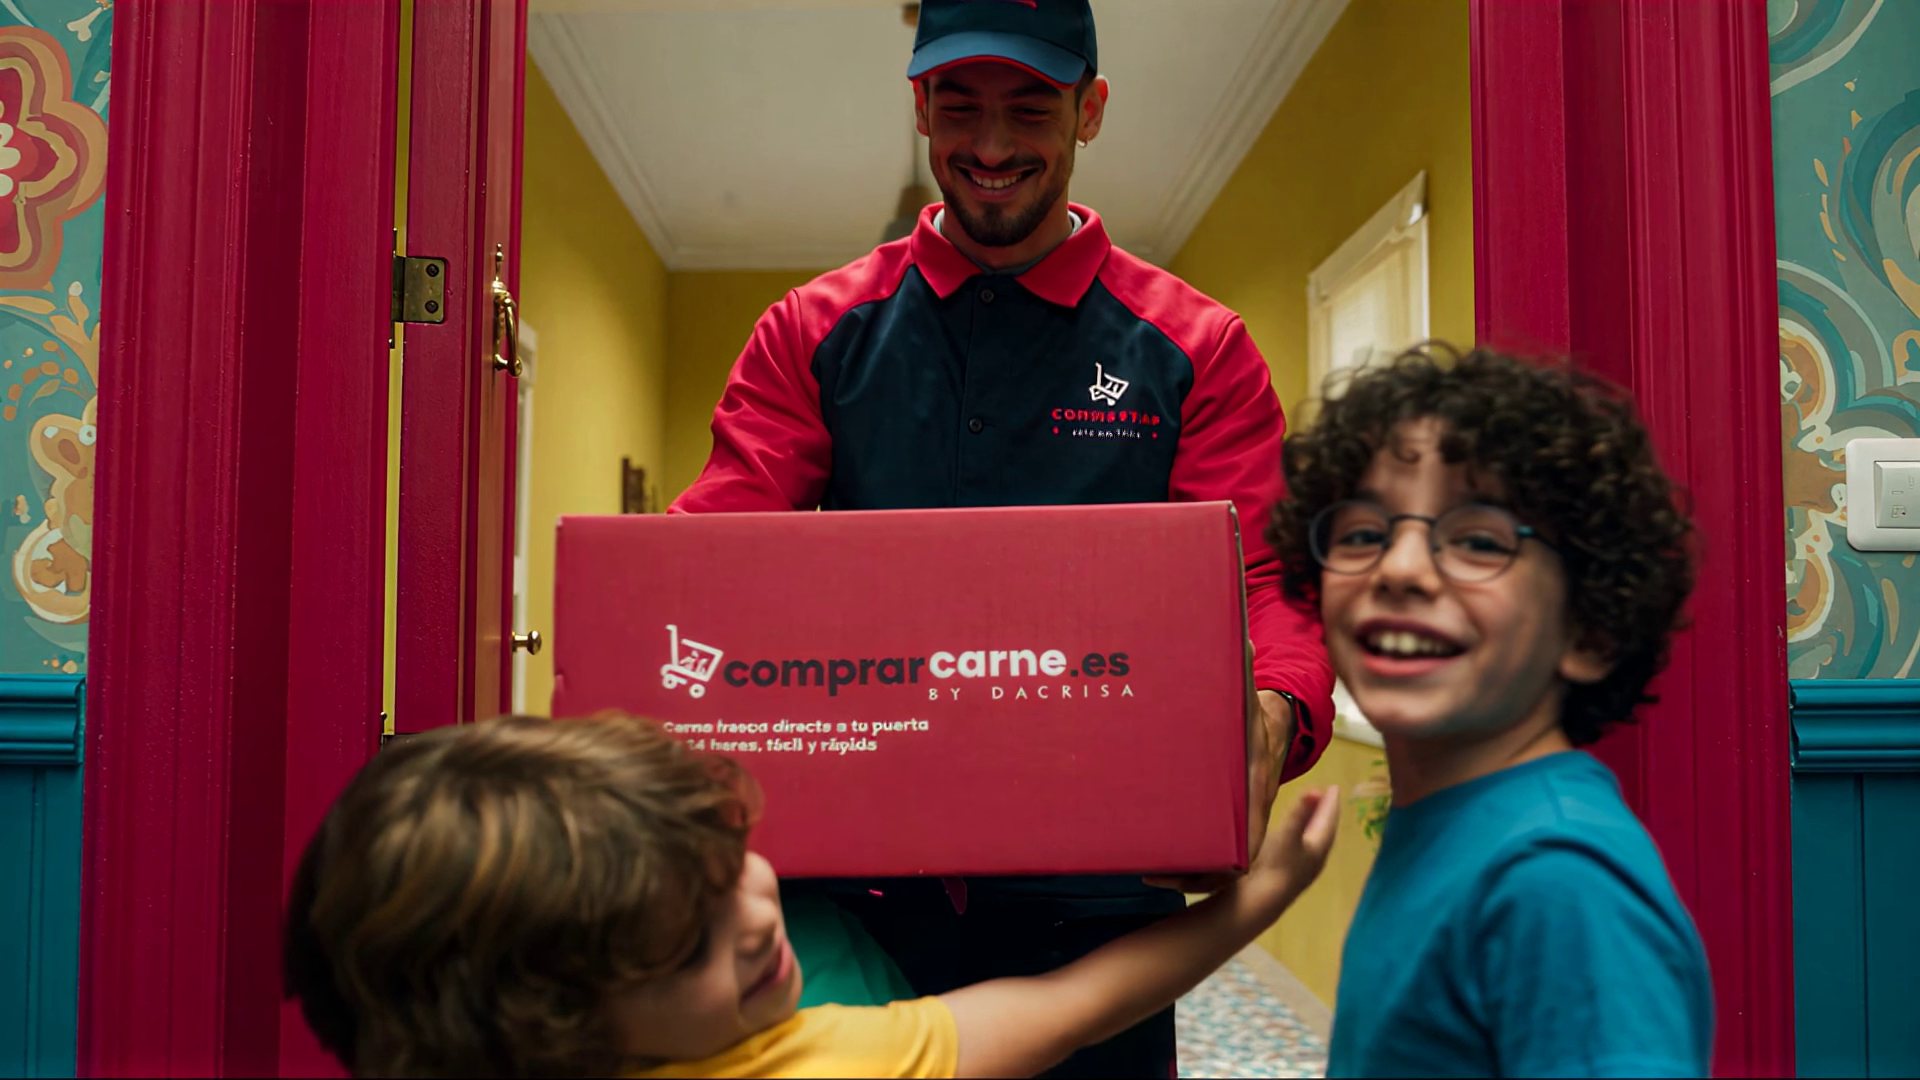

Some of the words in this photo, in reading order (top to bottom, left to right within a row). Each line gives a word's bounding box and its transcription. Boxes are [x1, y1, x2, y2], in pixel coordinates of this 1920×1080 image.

[723, 649, 1130, 697] comprarcarne.es
[928, 687, 961, 700] BY
[991, 684, 1134, 700] DACRISA
[851, 719, 868, 732] tu
[807, 741, 817, 755] y
